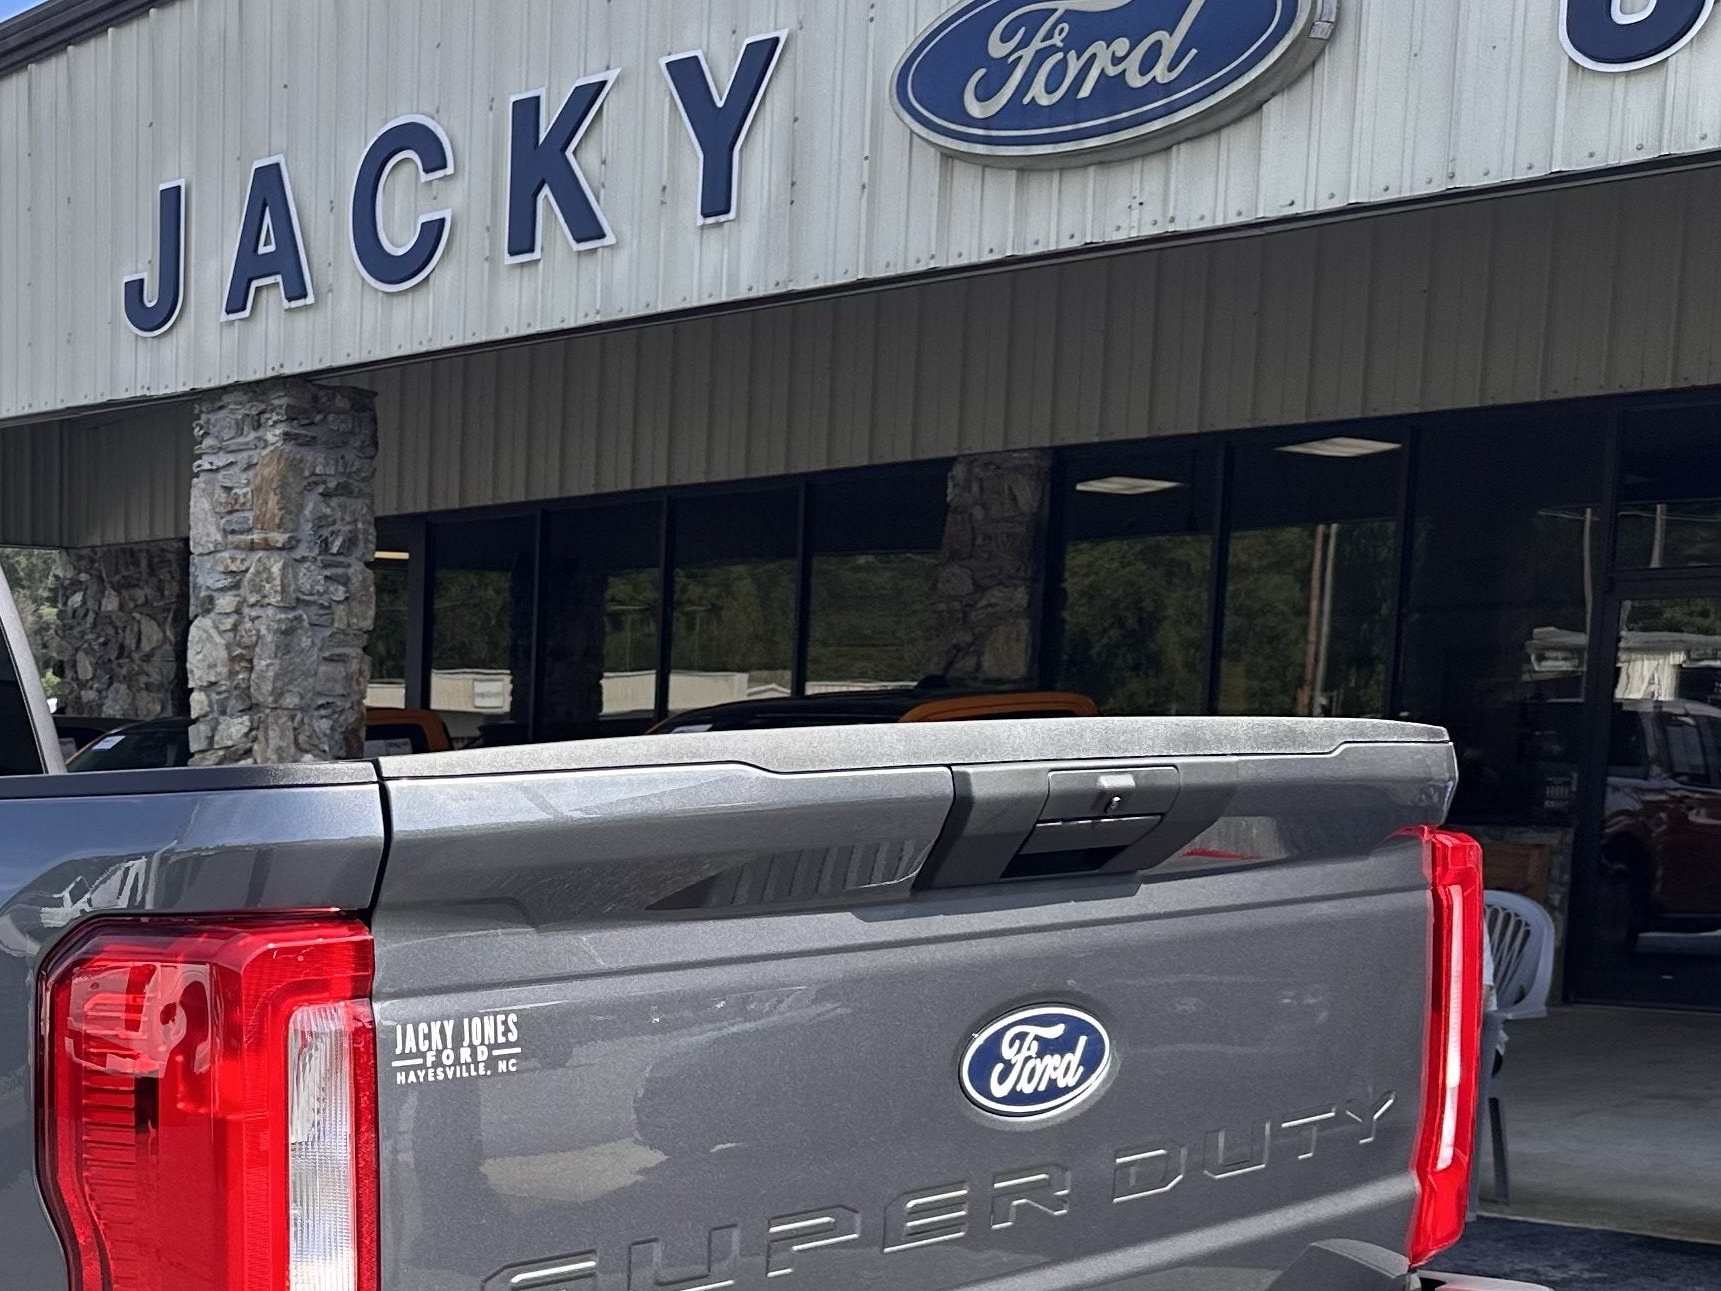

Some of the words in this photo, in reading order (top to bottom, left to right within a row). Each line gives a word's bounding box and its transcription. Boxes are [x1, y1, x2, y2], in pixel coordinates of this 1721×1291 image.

[964, 0, 1206, 119] Ford
[123, 28, 789, 337] JACKY
[395, 1019, 454, 1055] JACKY
[462, 1013, 518, 1047] JONES
[396, 1062, 492, 1085] HAYESVILLE,
[497, 1058, 517, 1073] NC
[426, 1045, 489, 1068] FORD
[990, 1023, 1088, 1098] Ford
[1111, 1089, 1398, 1206] DUTY
